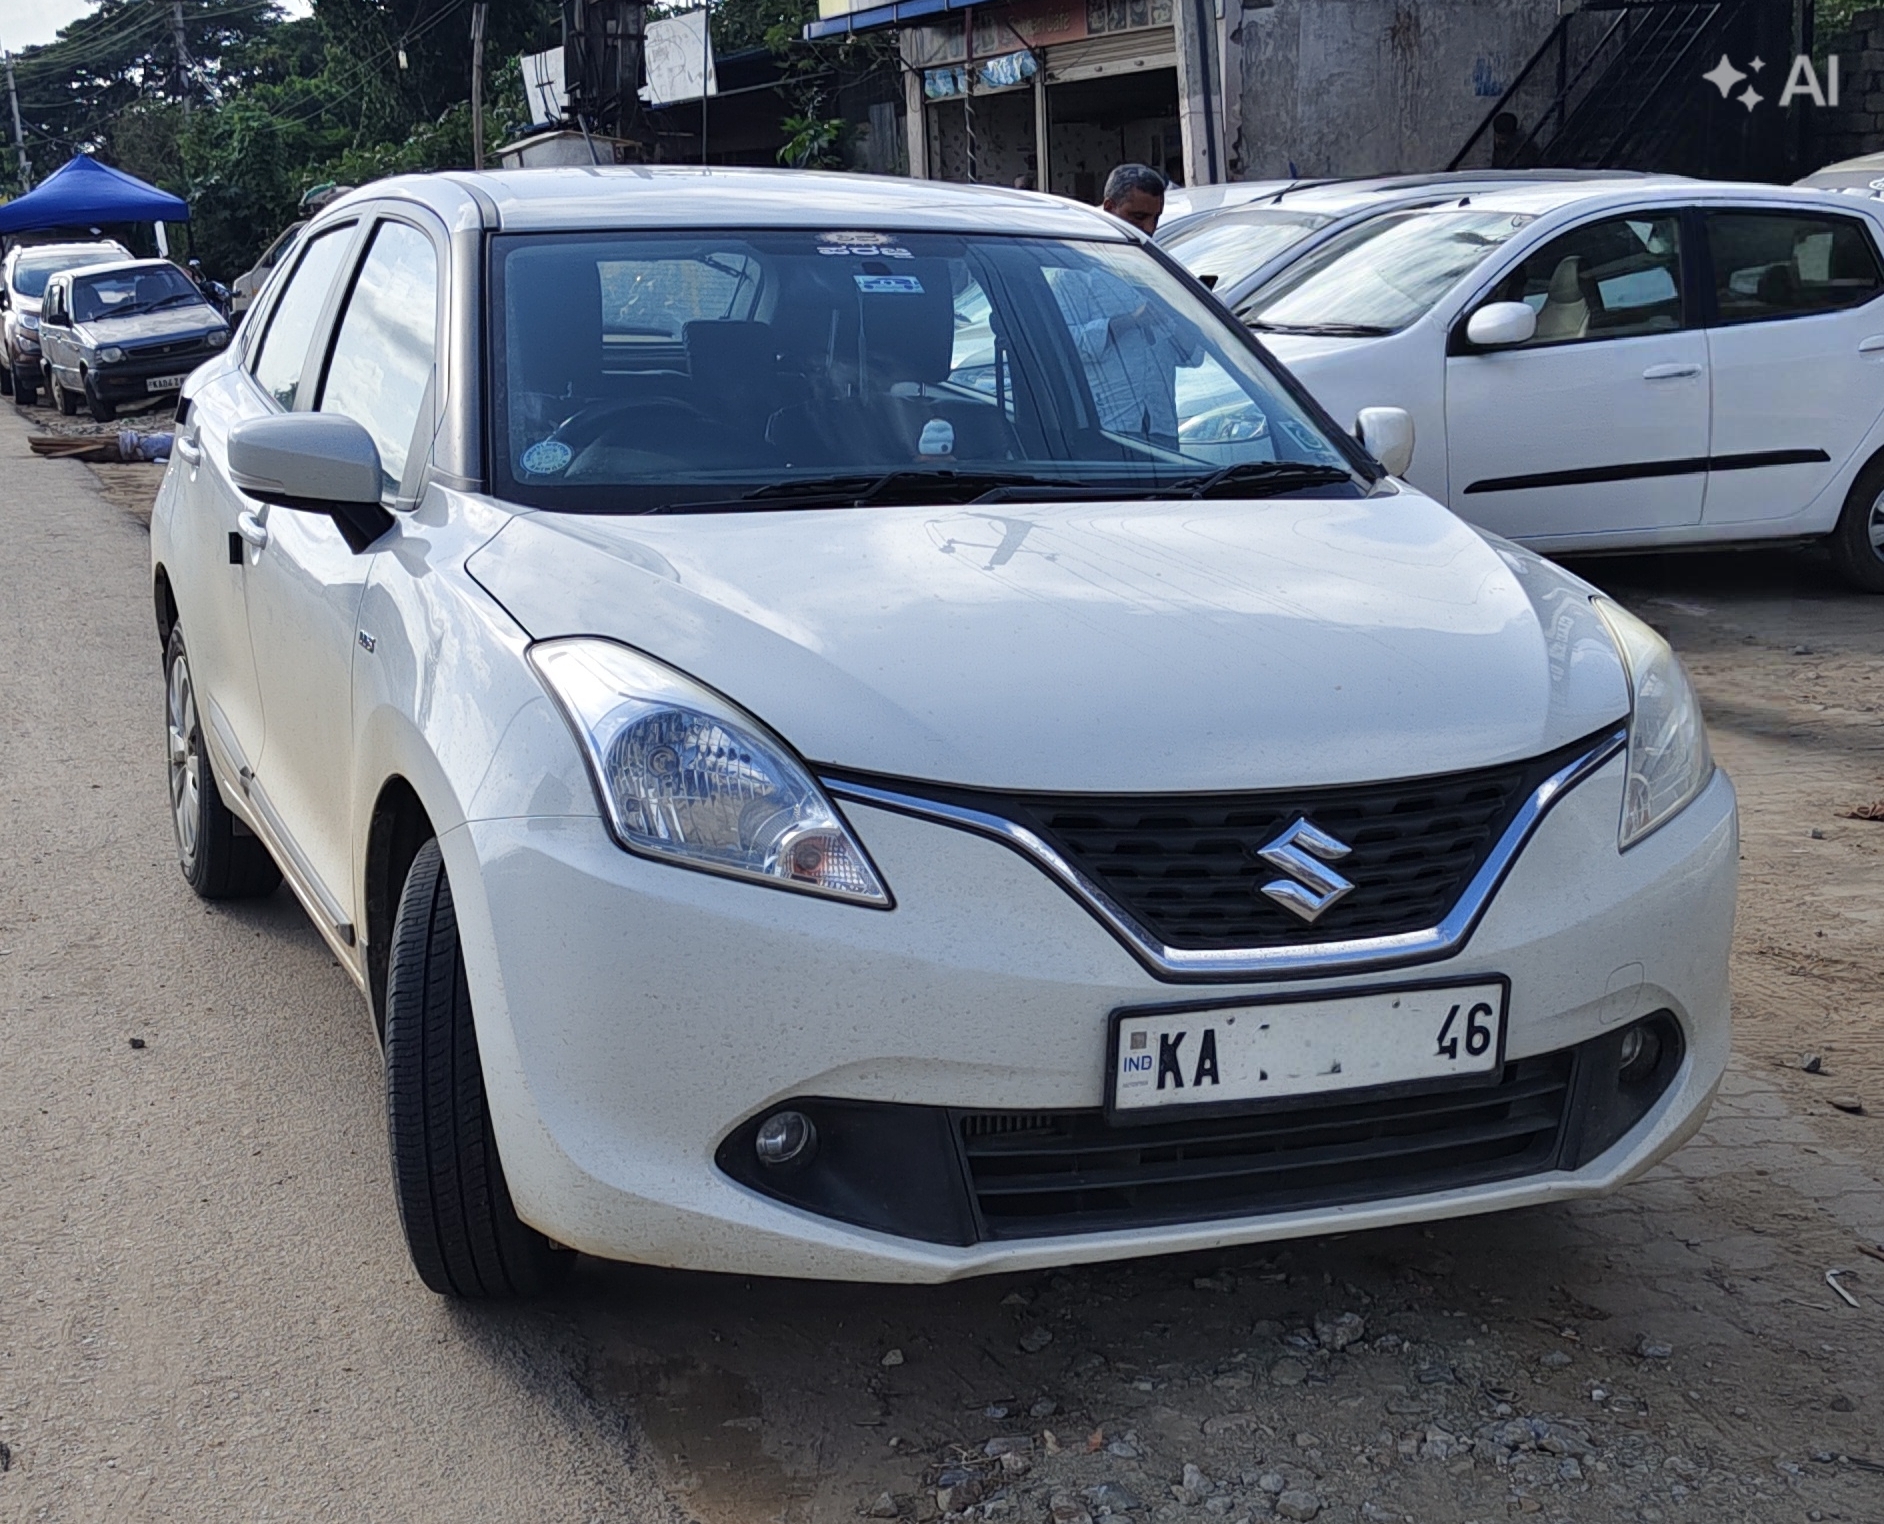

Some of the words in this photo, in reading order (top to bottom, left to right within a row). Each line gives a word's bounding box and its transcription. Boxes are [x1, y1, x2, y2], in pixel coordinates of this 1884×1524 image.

[1123, 1054, 1153, 1073] IND
[1156, 1029, 1220, 1090] KA
[1434, 1002, 1493, 1060] 46
